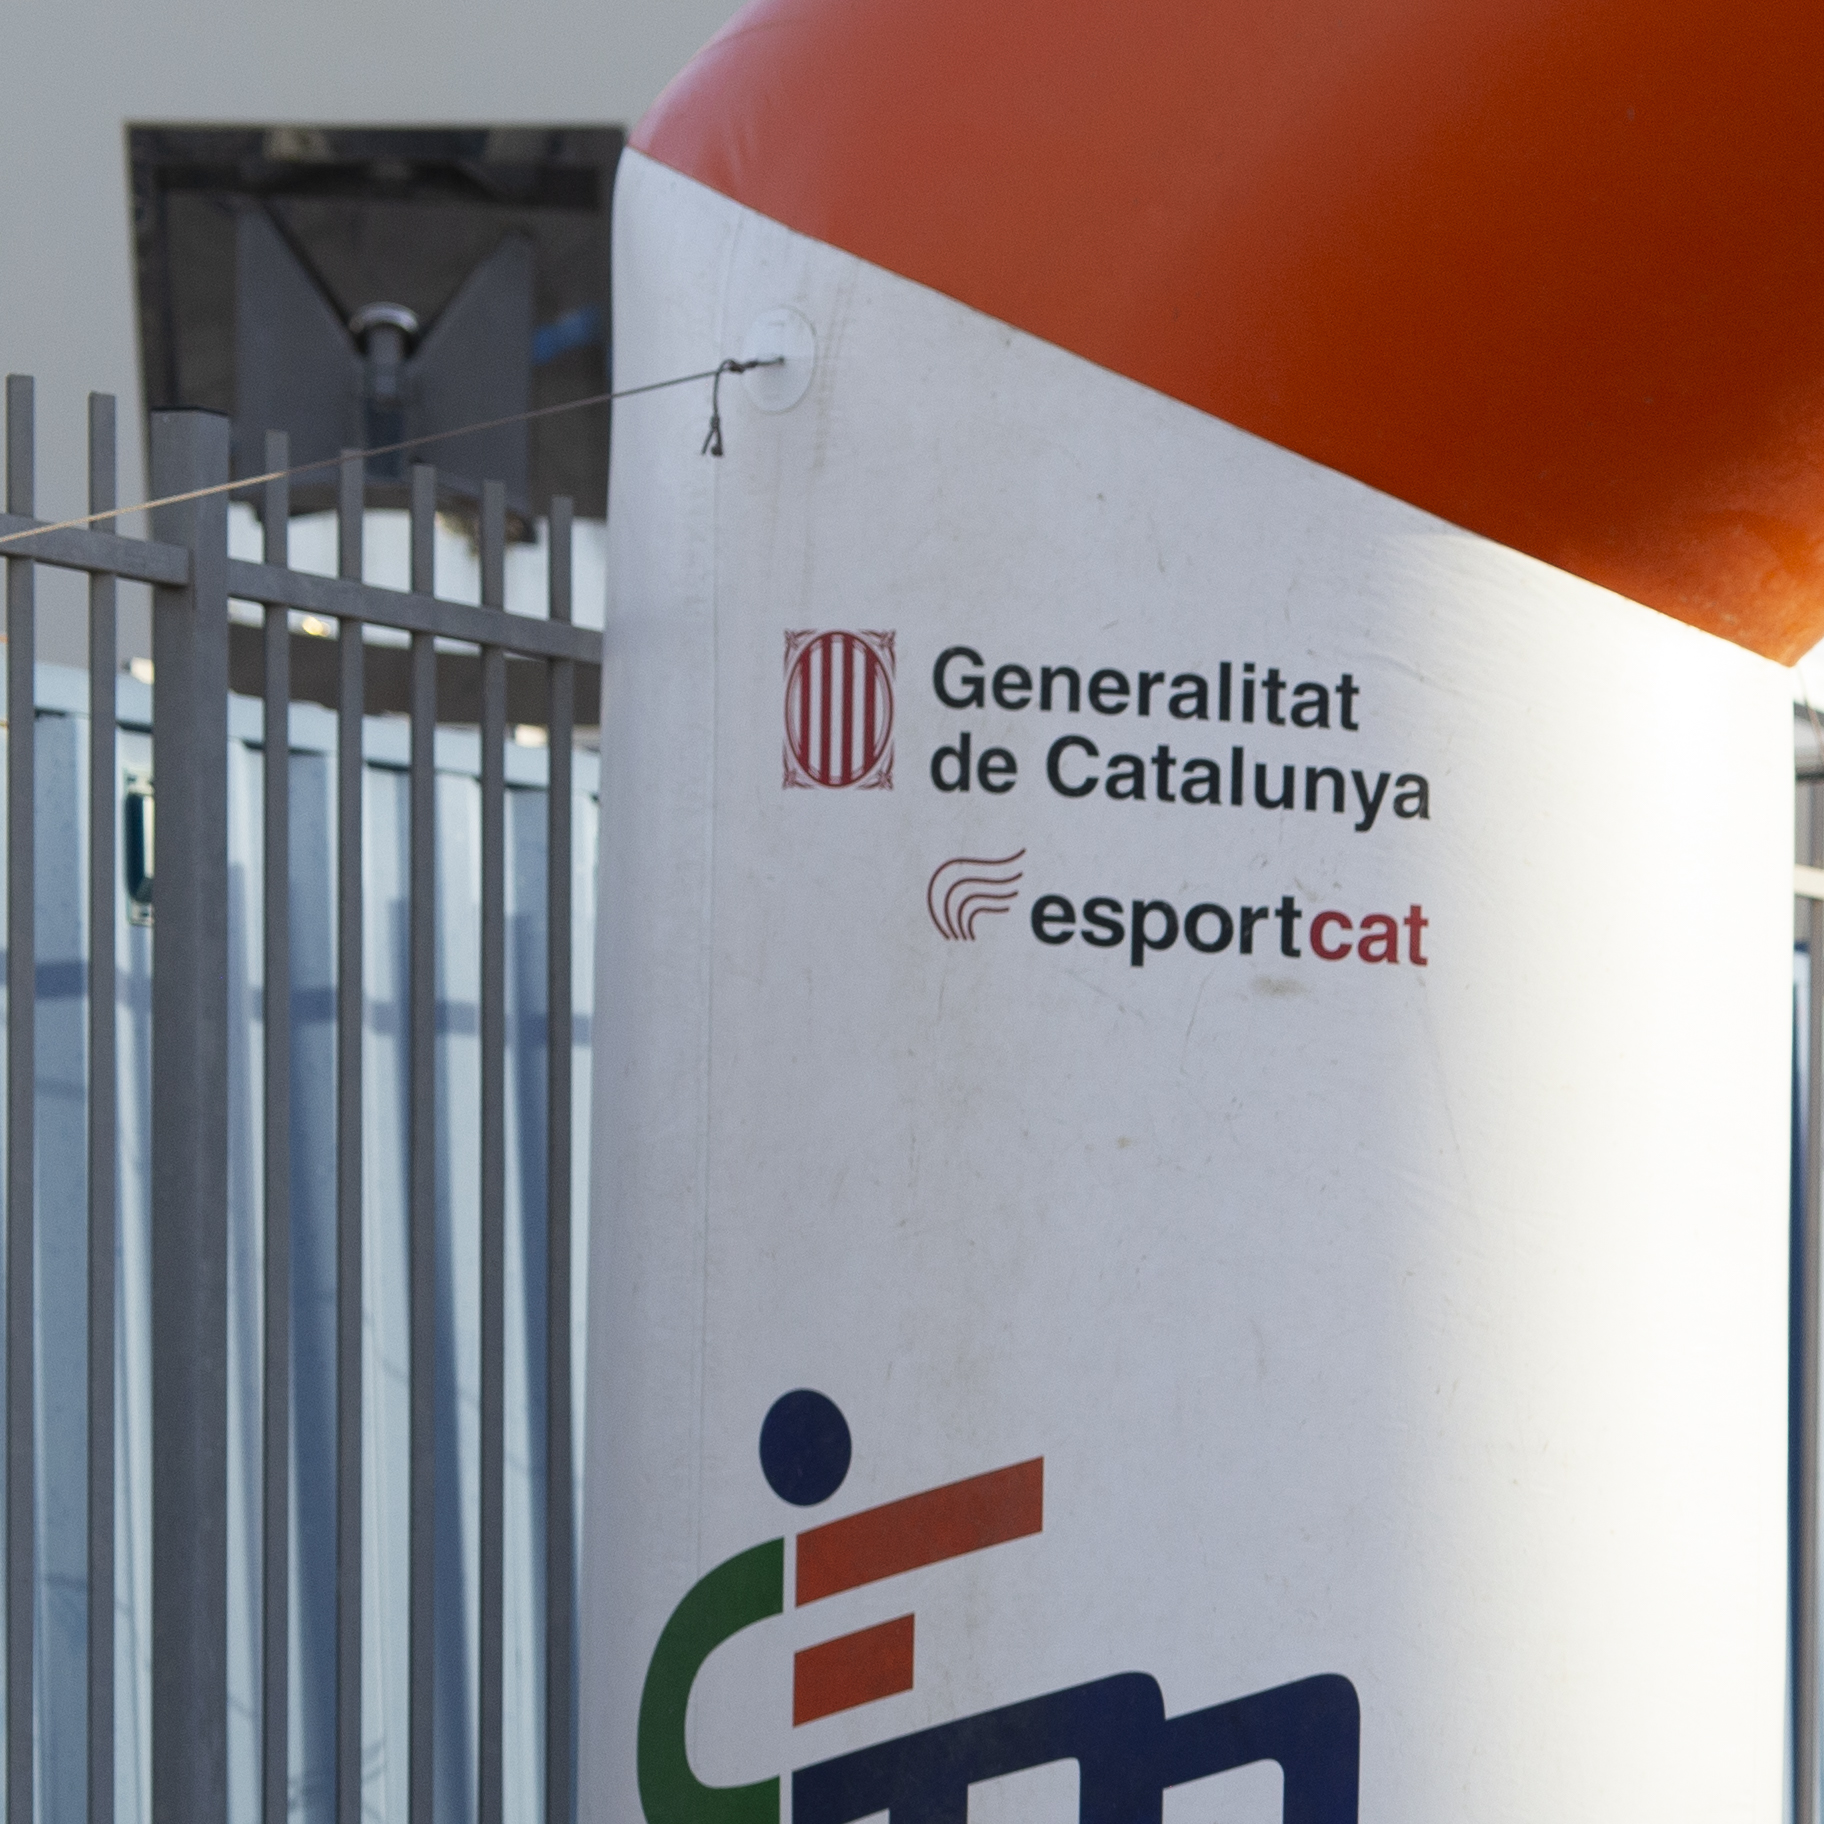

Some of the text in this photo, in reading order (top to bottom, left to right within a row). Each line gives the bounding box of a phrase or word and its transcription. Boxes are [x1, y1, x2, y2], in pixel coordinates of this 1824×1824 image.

[931, 646, 1360, 732] Generalitat
[929, 732, 1431, 833] de Catalunya
[1029, 892, 1430, 968] esportcat
